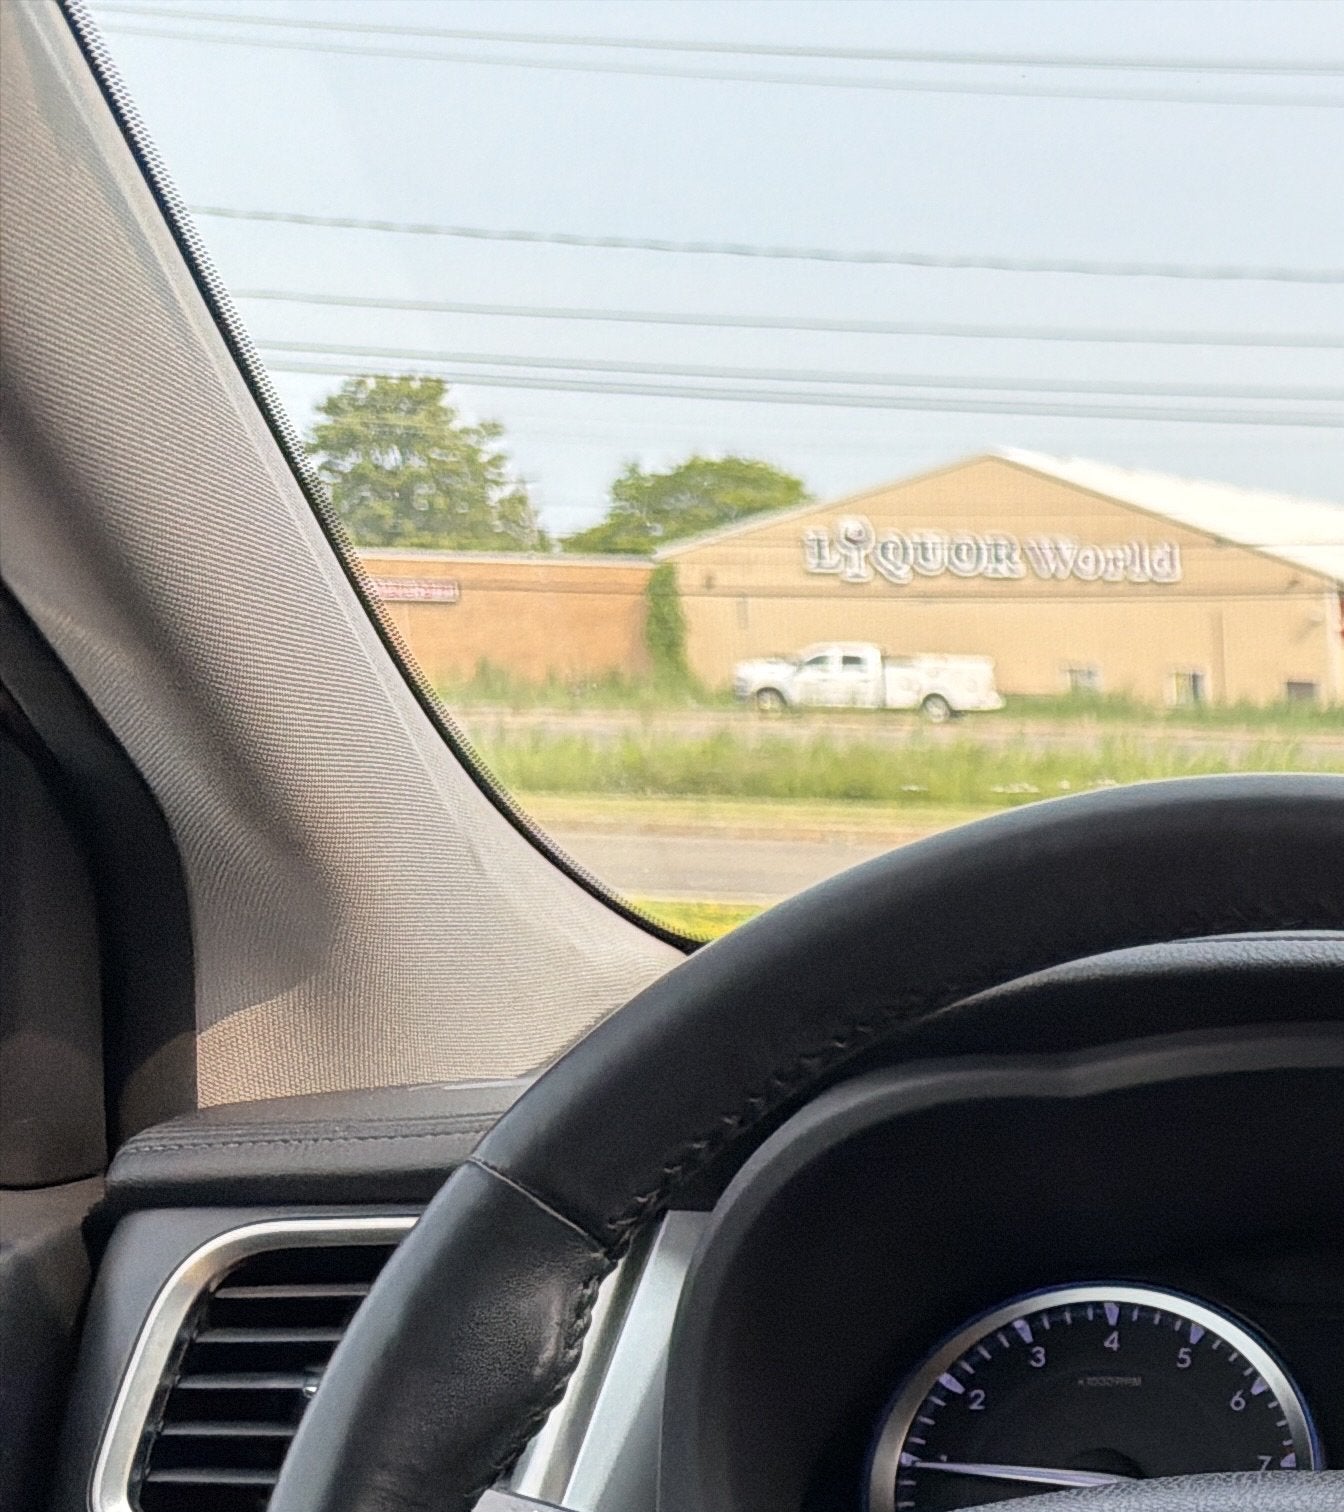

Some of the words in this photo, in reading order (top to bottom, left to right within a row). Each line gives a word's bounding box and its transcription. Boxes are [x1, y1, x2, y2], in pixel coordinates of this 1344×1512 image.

[1026, 535, 1182, 583] World
[1103, 1331, 1120, 1351] 4
[1029, 1347, 1046, 1368] 3
[1176, 1348, 1192, 1369] 5
[969, 1391, 987, 1410] 2
[1230, 1391, 1246, 1411] 6
[1257, 1457, 1271, 1472] 7
